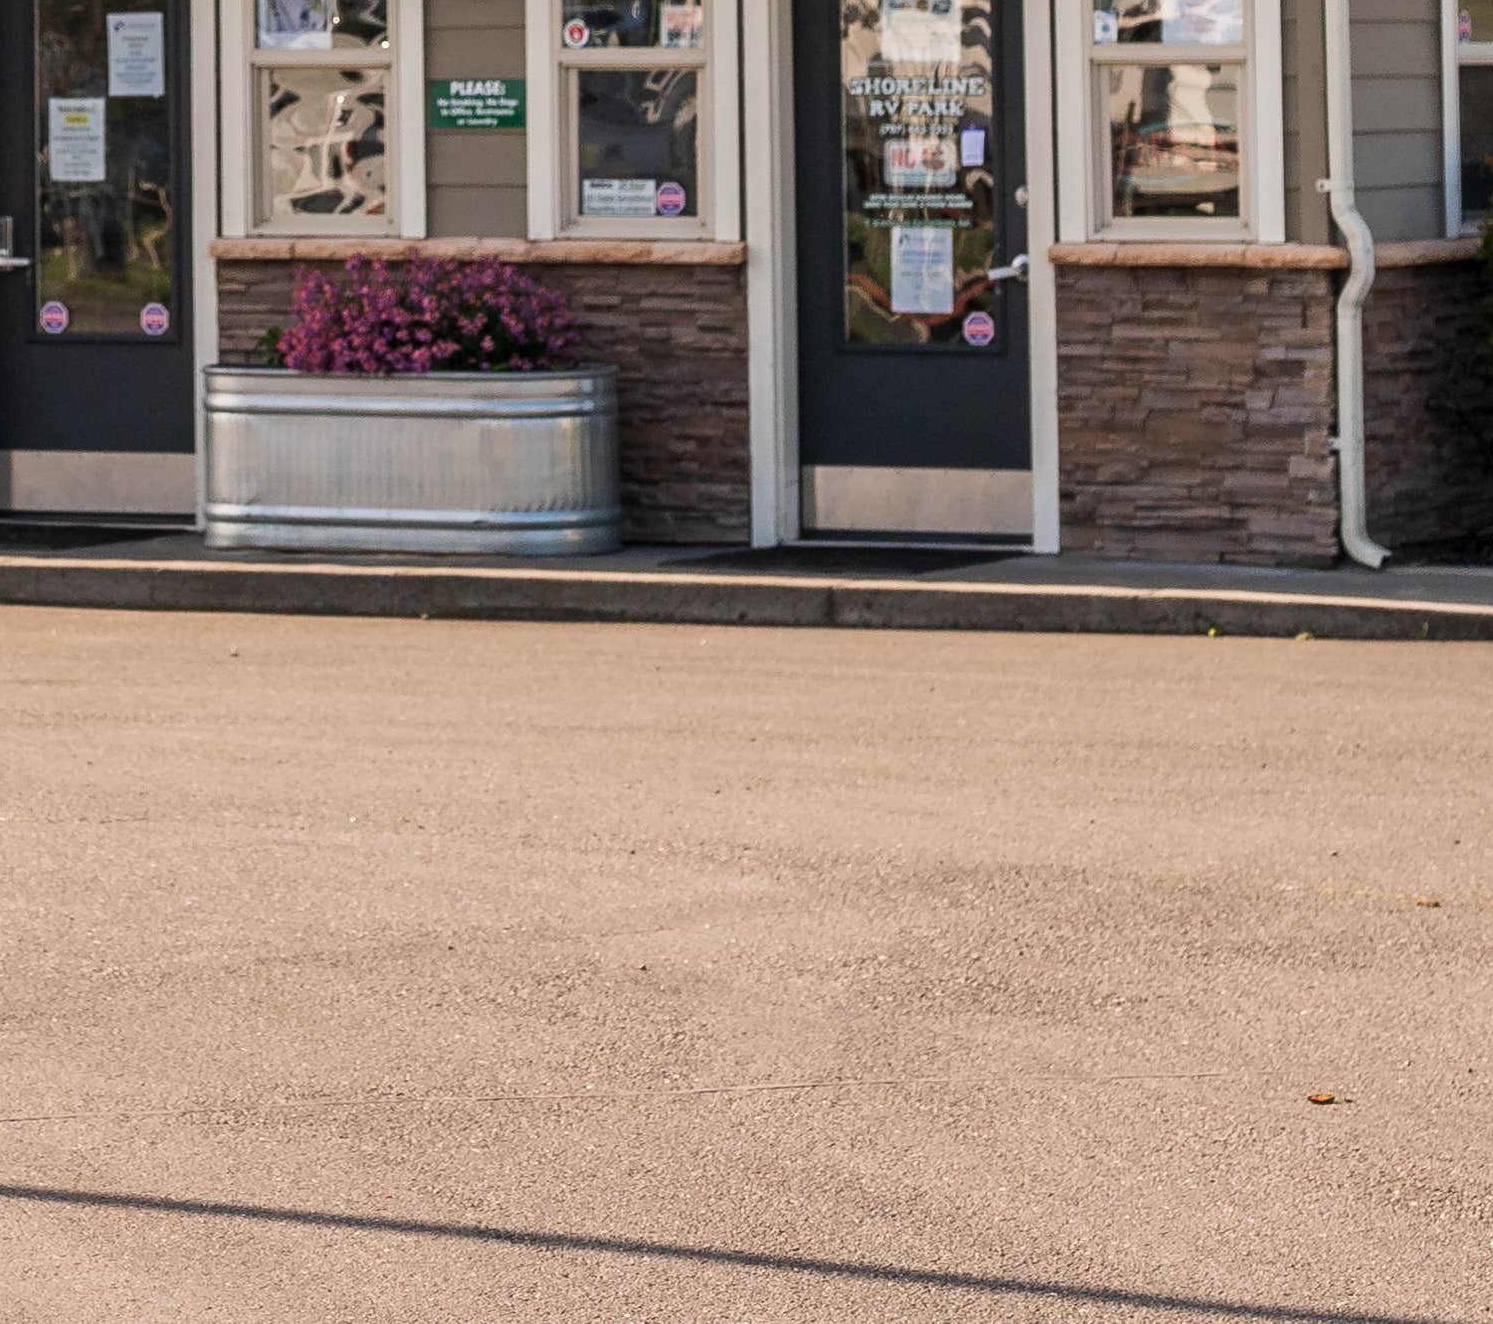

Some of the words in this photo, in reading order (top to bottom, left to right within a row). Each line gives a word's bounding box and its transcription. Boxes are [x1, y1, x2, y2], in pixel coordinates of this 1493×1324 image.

[850, 76, 985, 96] SHORELINE
[869, 100, 900, 117] RV
[907, 99, 964, 117] PARK
